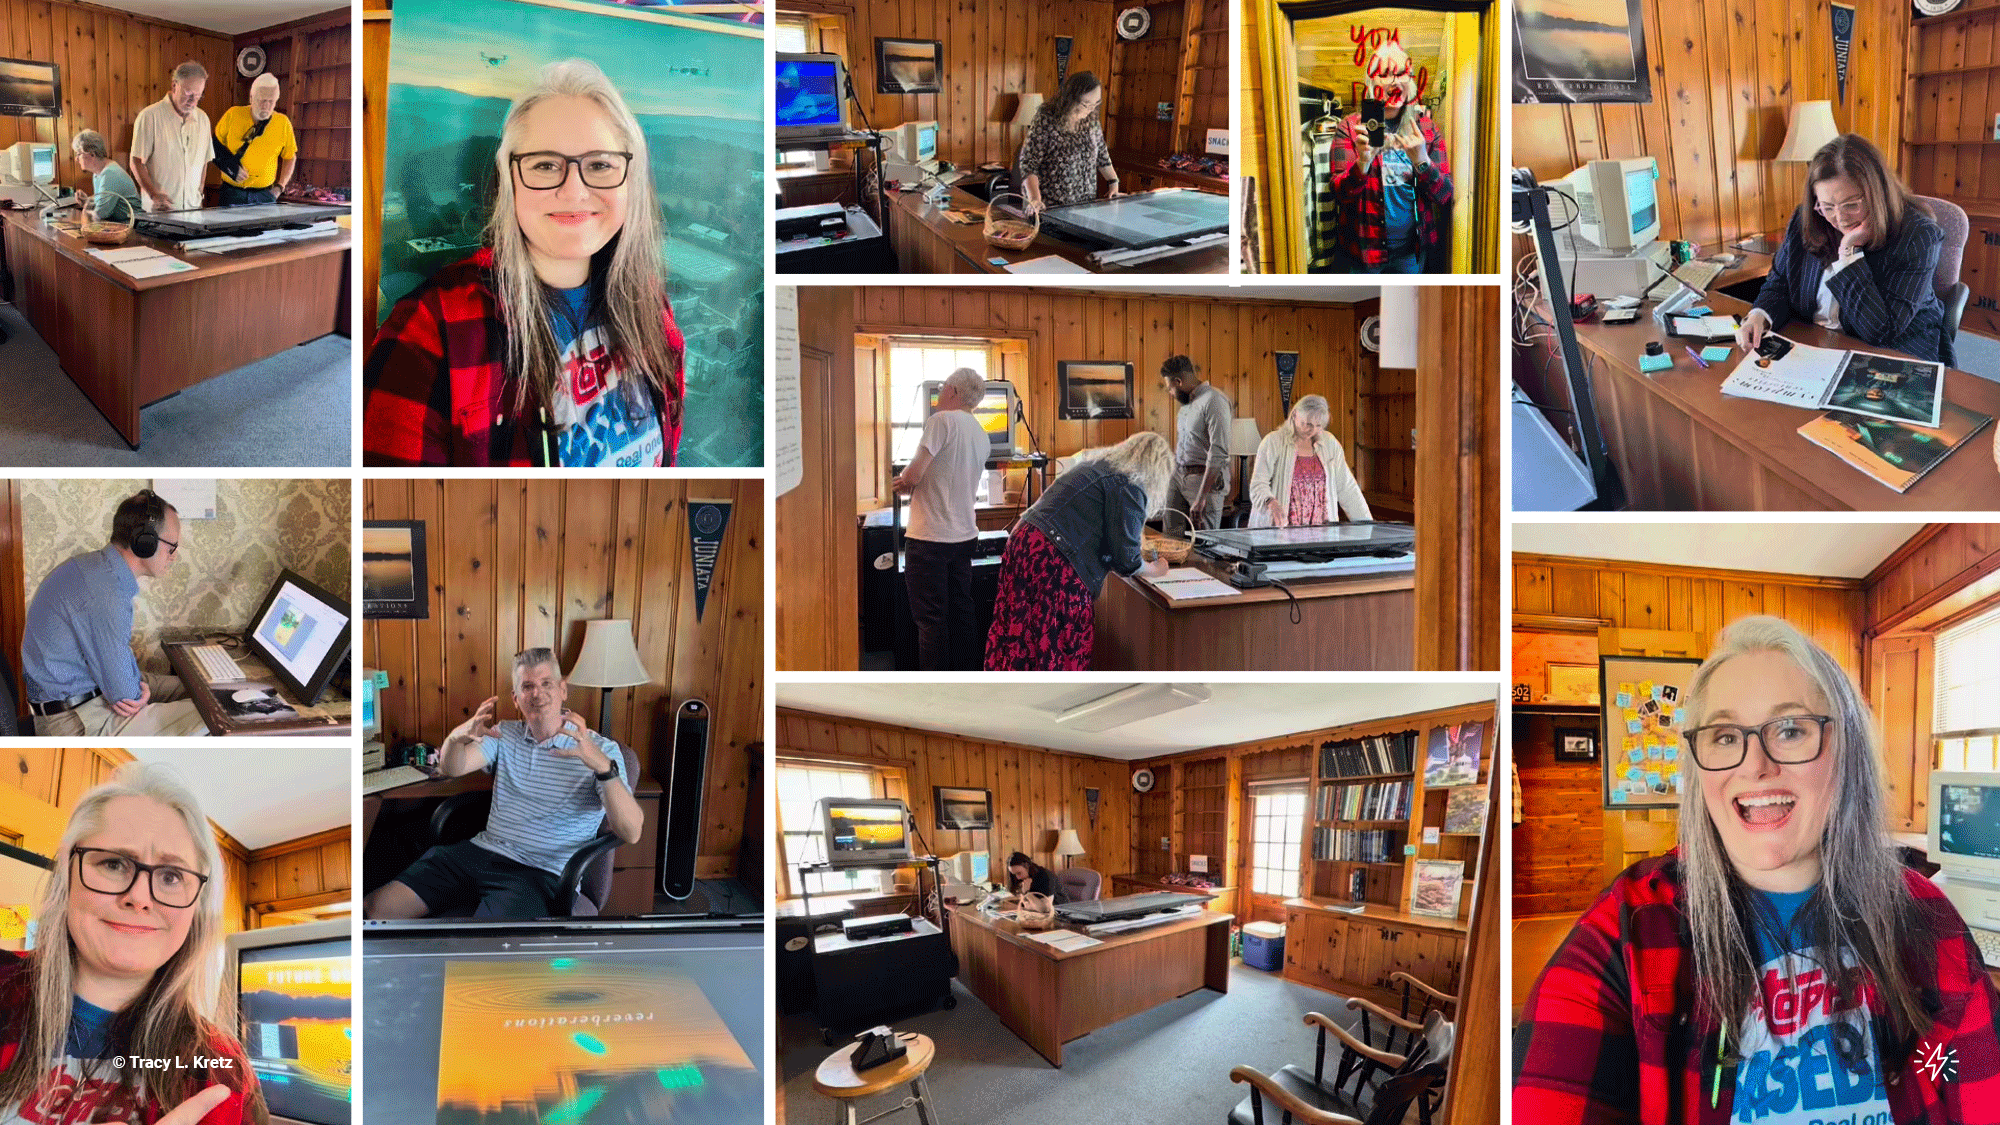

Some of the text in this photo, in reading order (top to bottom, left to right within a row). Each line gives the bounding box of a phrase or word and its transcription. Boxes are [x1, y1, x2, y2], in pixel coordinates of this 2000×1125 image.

[1350, 24, 1400, 67] you
[1834, 35, 1849, 80] JUNIATA
[693, 537, 719, 590] JUNIATA
[504, 1012, 654, 1028] reverberations
